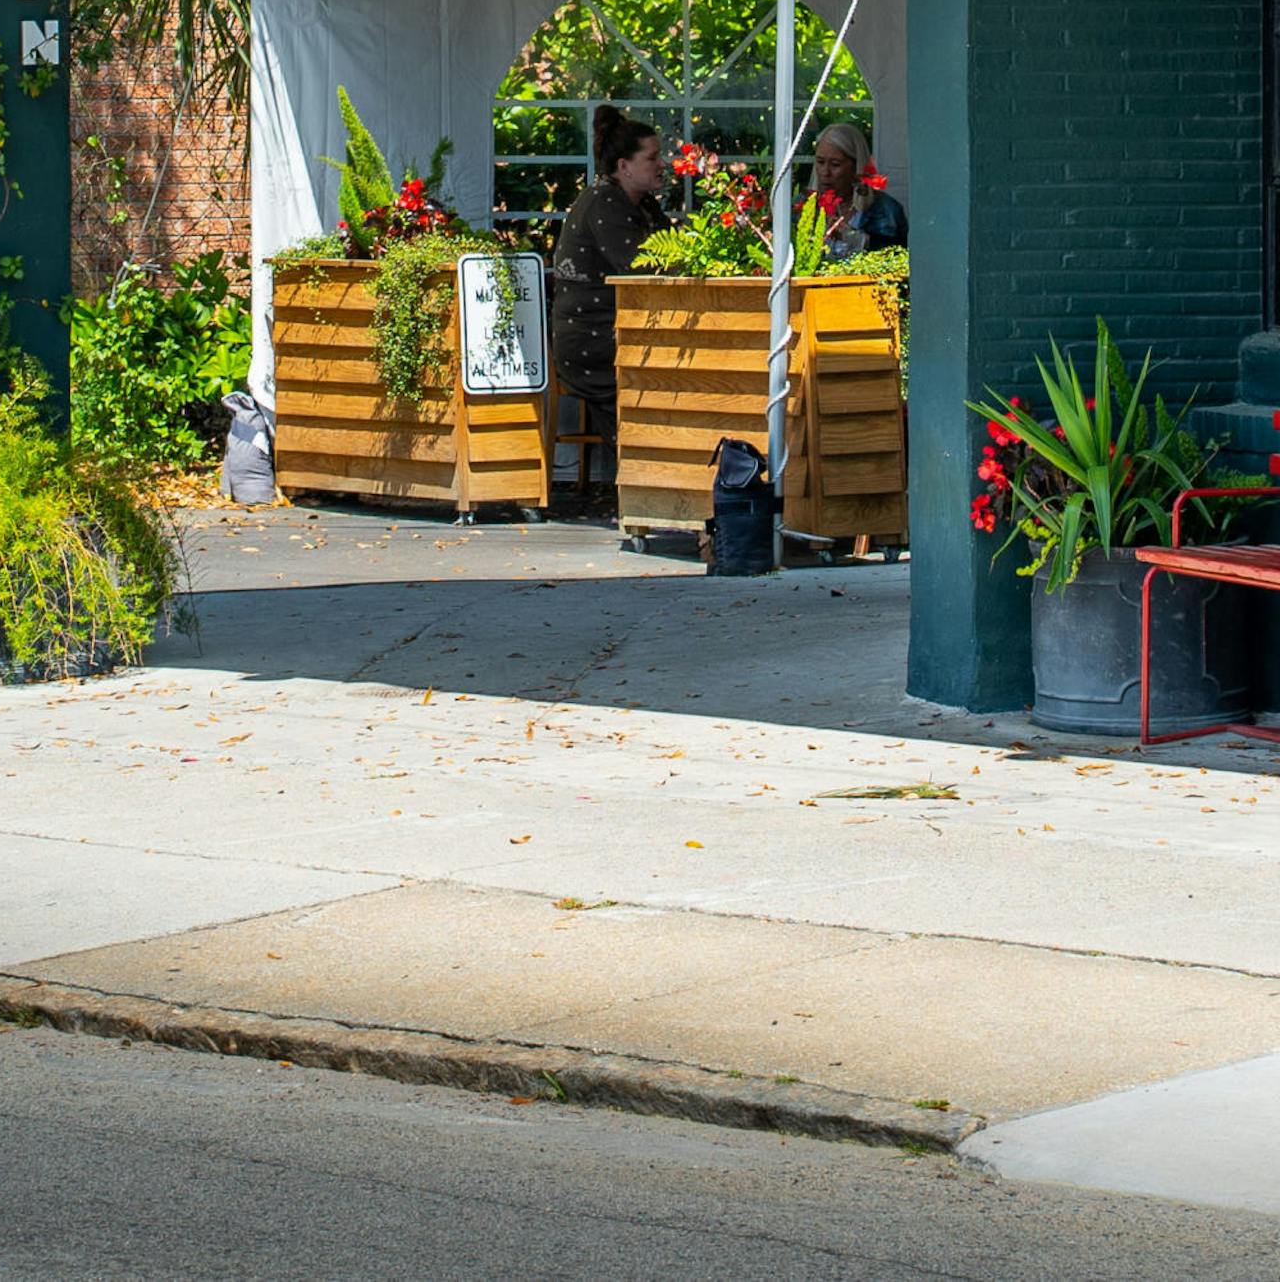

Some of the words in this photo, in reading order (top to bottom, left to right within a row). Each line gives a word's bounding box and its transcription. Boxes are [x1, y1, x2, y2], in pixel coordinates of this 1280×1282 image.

[475, 286, 512, 303] MUS
[472, 362, 497, 377] ALL
[501, 361, 539, 376] TIMES
